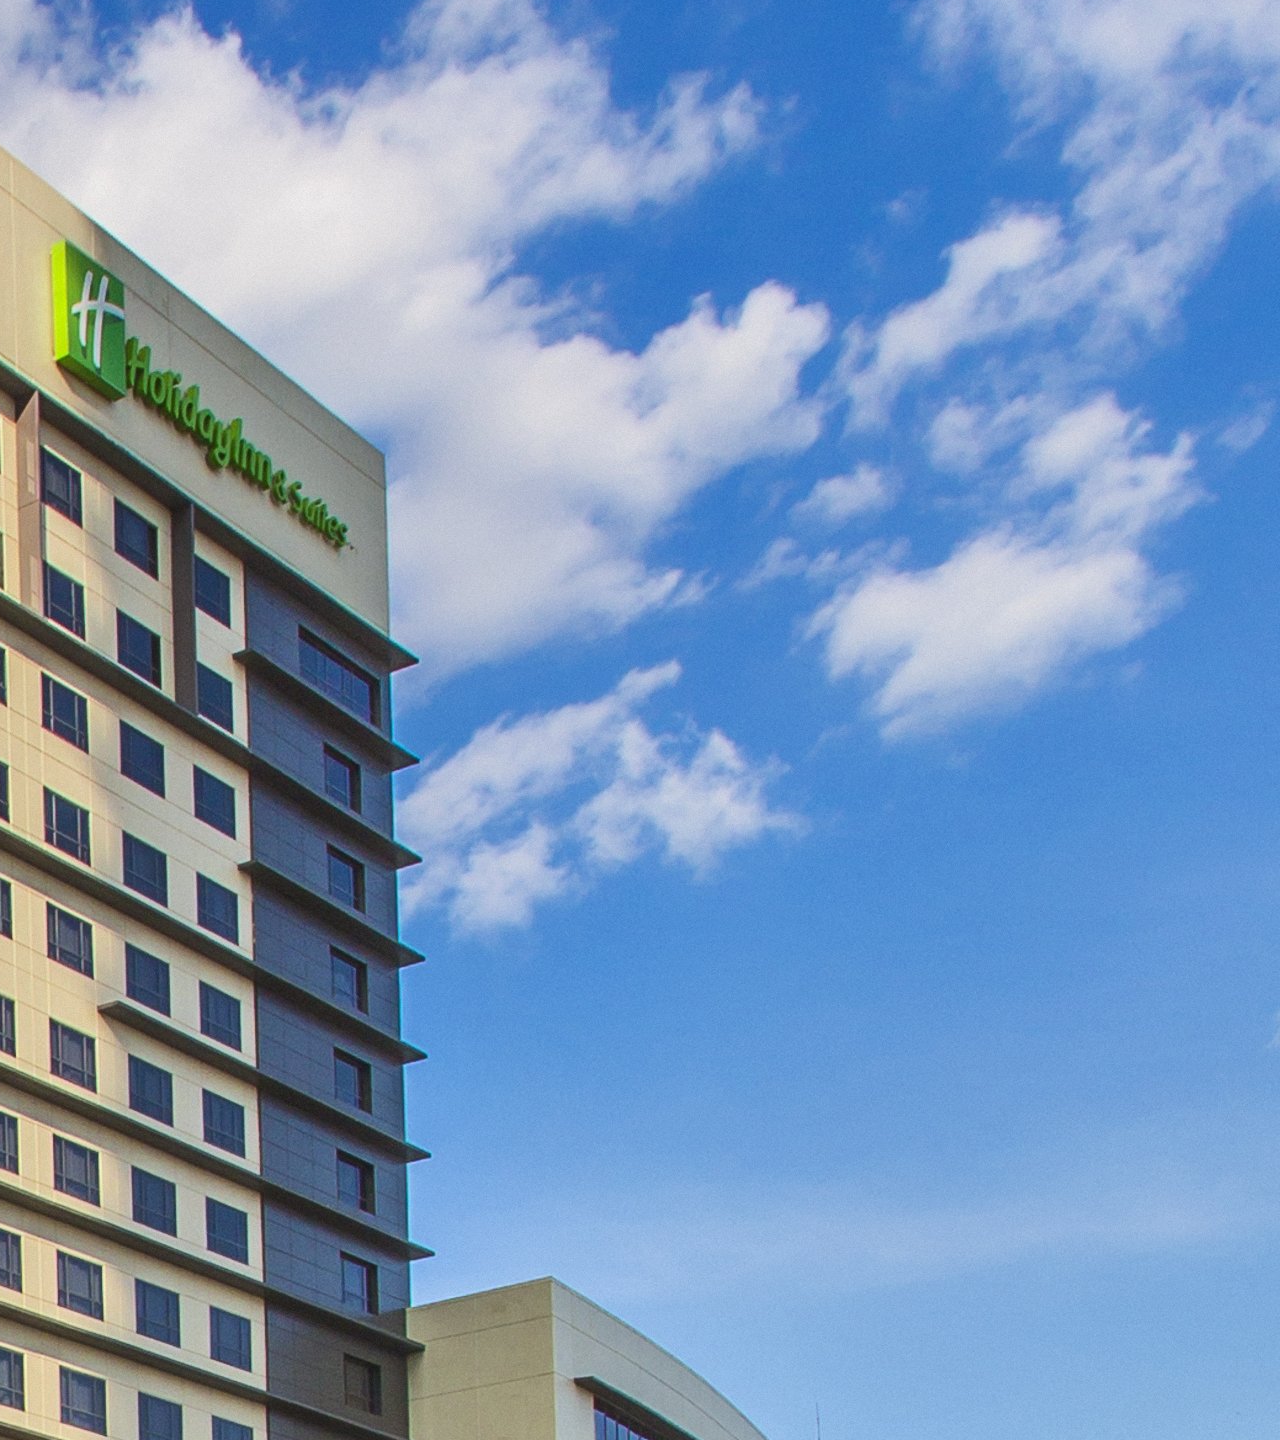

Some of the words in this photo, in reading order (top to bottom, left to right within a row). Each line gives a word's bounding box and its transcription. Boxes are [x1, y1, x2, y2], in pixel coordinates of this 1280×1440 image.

[125, 336, 232, 469] Holiday
[229, 417, 272, 490] Inn
[270, 469, 290, 504] &
[288, 480, 350, 547] Suites
